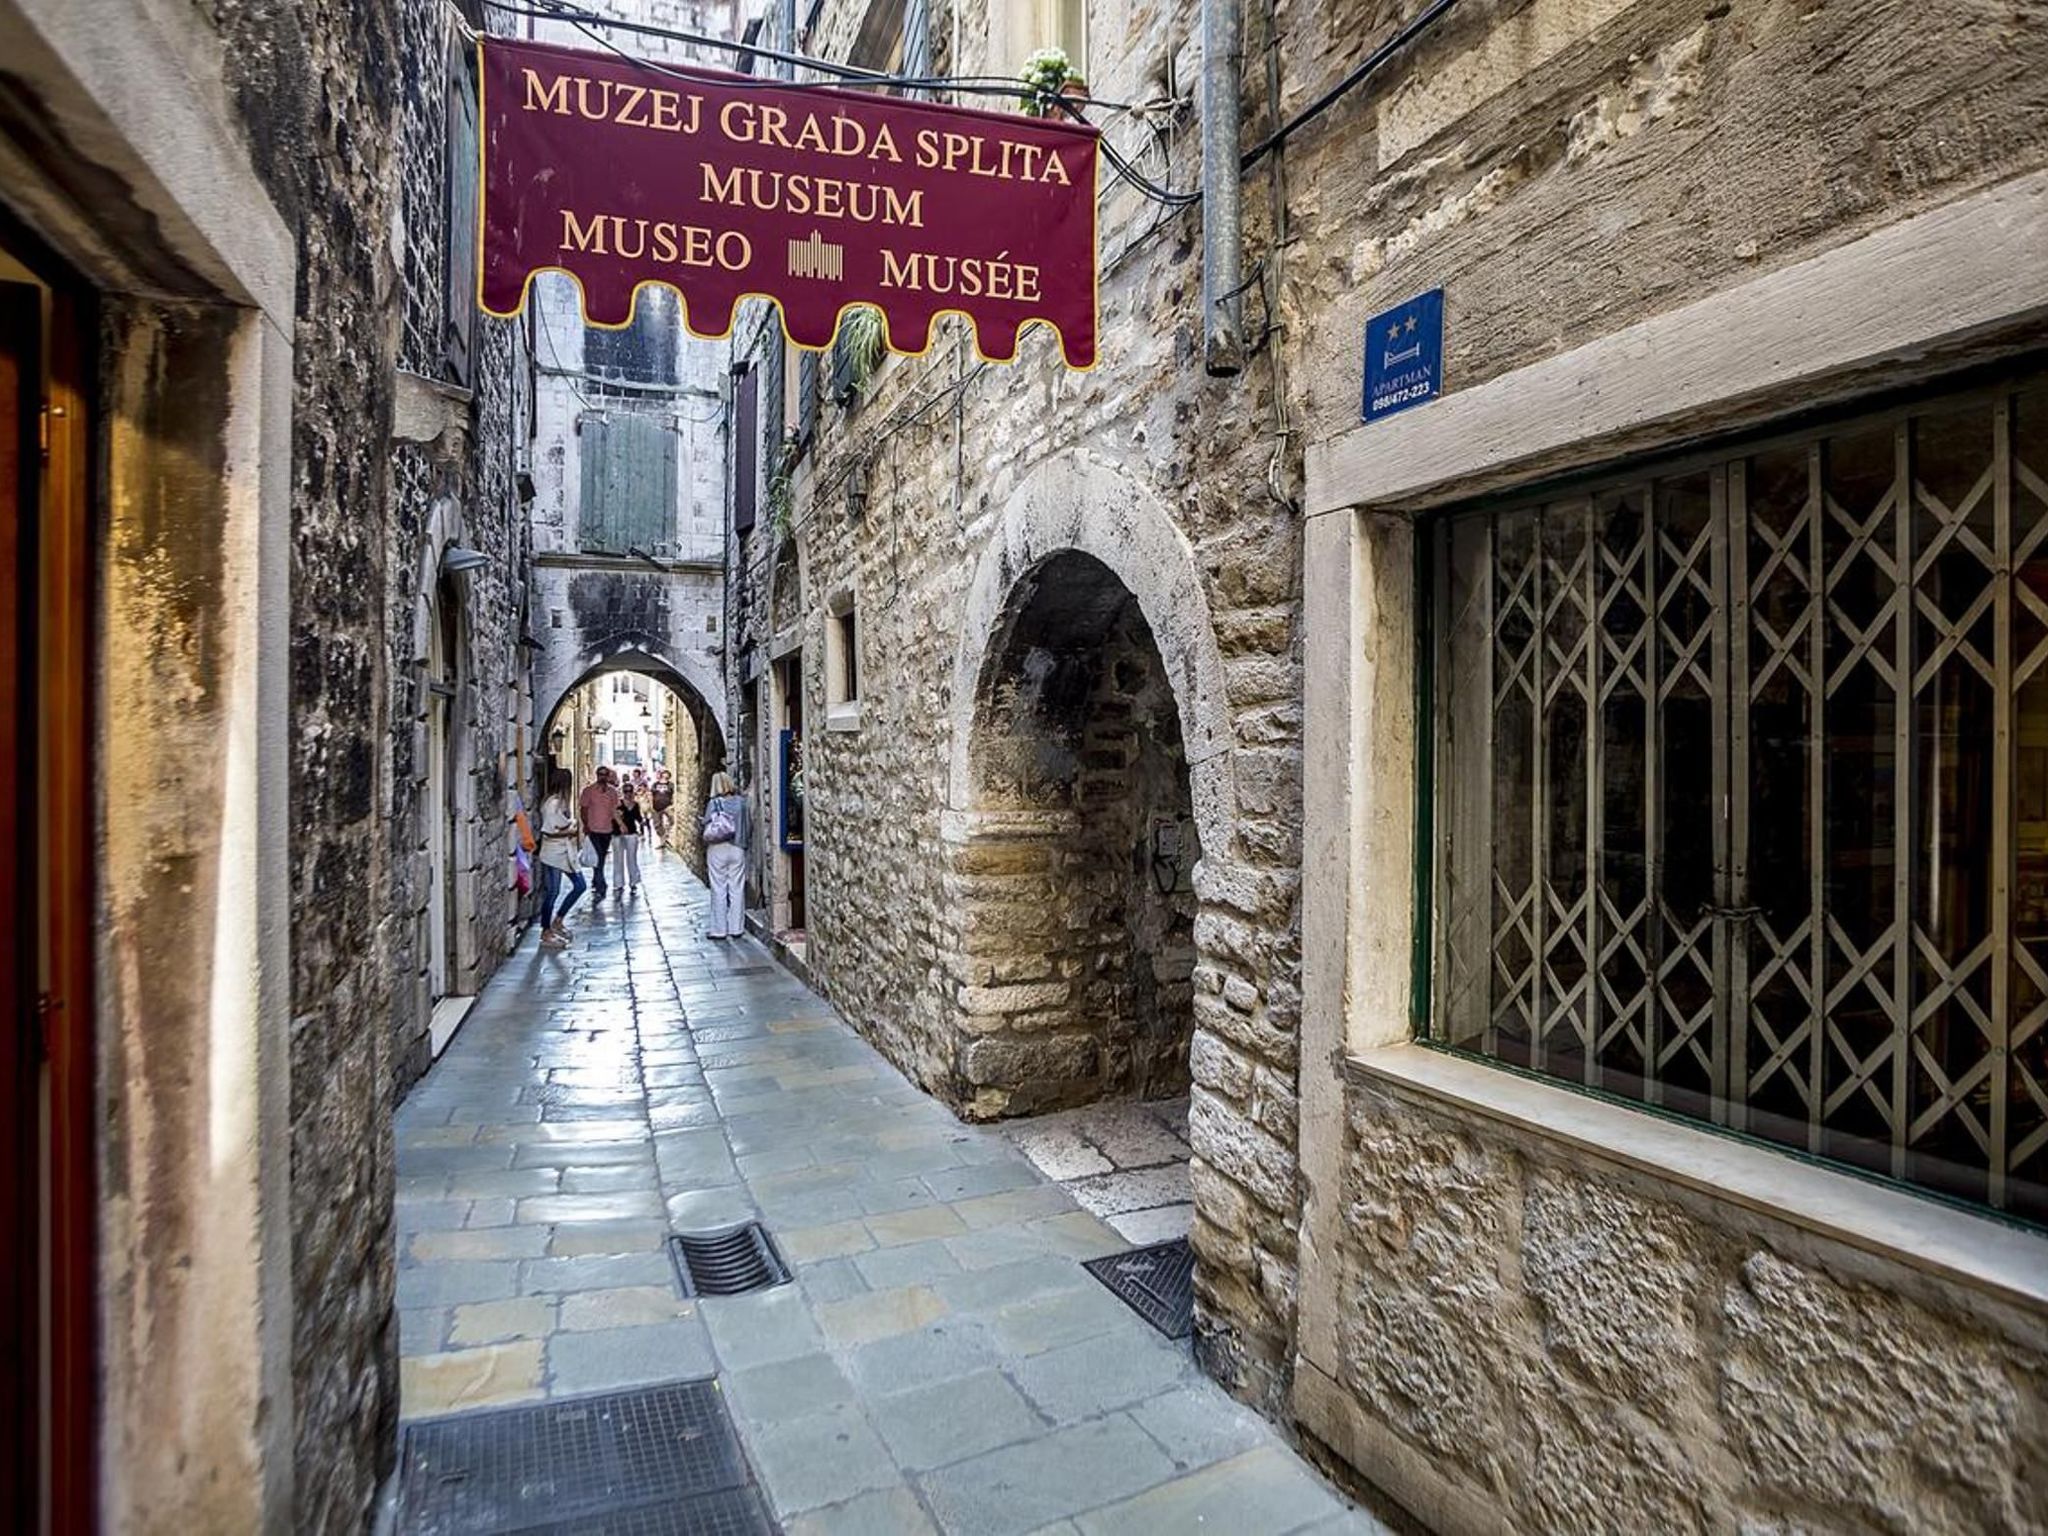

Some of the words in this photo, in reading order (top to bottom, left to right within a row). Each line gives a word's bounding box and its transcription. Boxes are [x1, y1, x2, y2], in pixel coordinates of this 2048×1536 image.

[521, 68, 704, 135] MUZEJ
[720, 101, 903, 163] GRADA
[916, 129, 1071, 186] SPLITA
[699, 162, 924, 228] MUSEUM
[559, 209, 752, 271] MUSEO
[879, 249, 1042, 302] MUSÉE
[1372, 364, 1432, 396] APARTMAN
